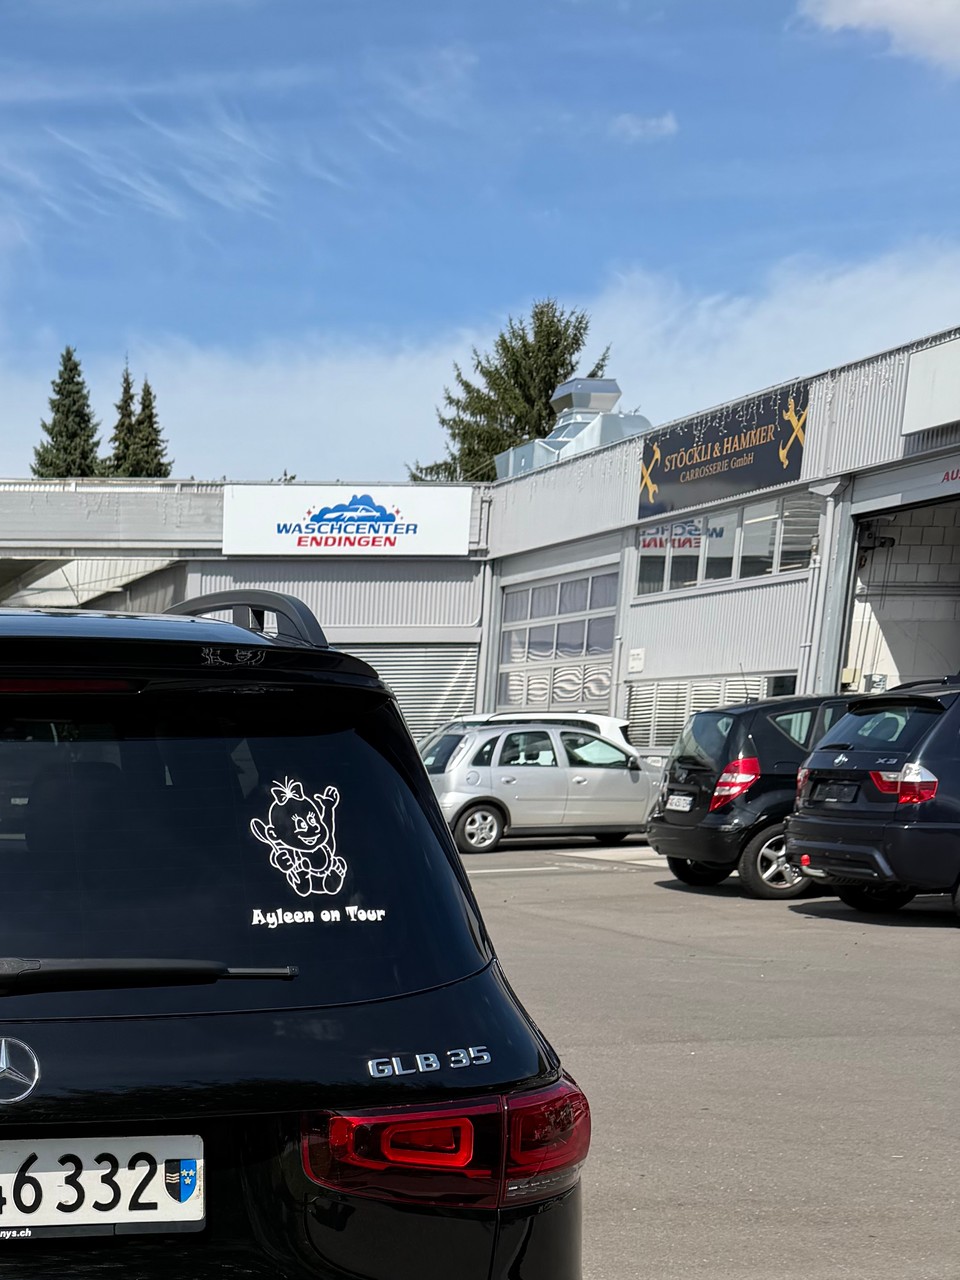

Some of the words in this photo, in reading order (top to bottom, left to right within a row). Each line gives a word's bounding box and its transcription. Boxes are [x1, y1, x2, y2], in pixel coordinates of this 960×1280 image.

[664, 442, 712, 472] STÖCKLI
[713, 445, 721, 458] &
[723, 424, 776, 455] HAMMER
[680, 458, 729, 483] CARROSSERIE
[730, 452, 755, 469] GmbH
[941, 468, 960, 483] AU
[276, 522, 418, 535] WASCHCENTER
[297, 536, 397, 547] ENDINGEN
[251, 907, 315, 929] Ayleen
[320, 909, 341, 922] on
[344, 905, 386, 922] Tour
[367, 1053, 441, 1079] GLB
[446, 1045, 492, 1069] 35
